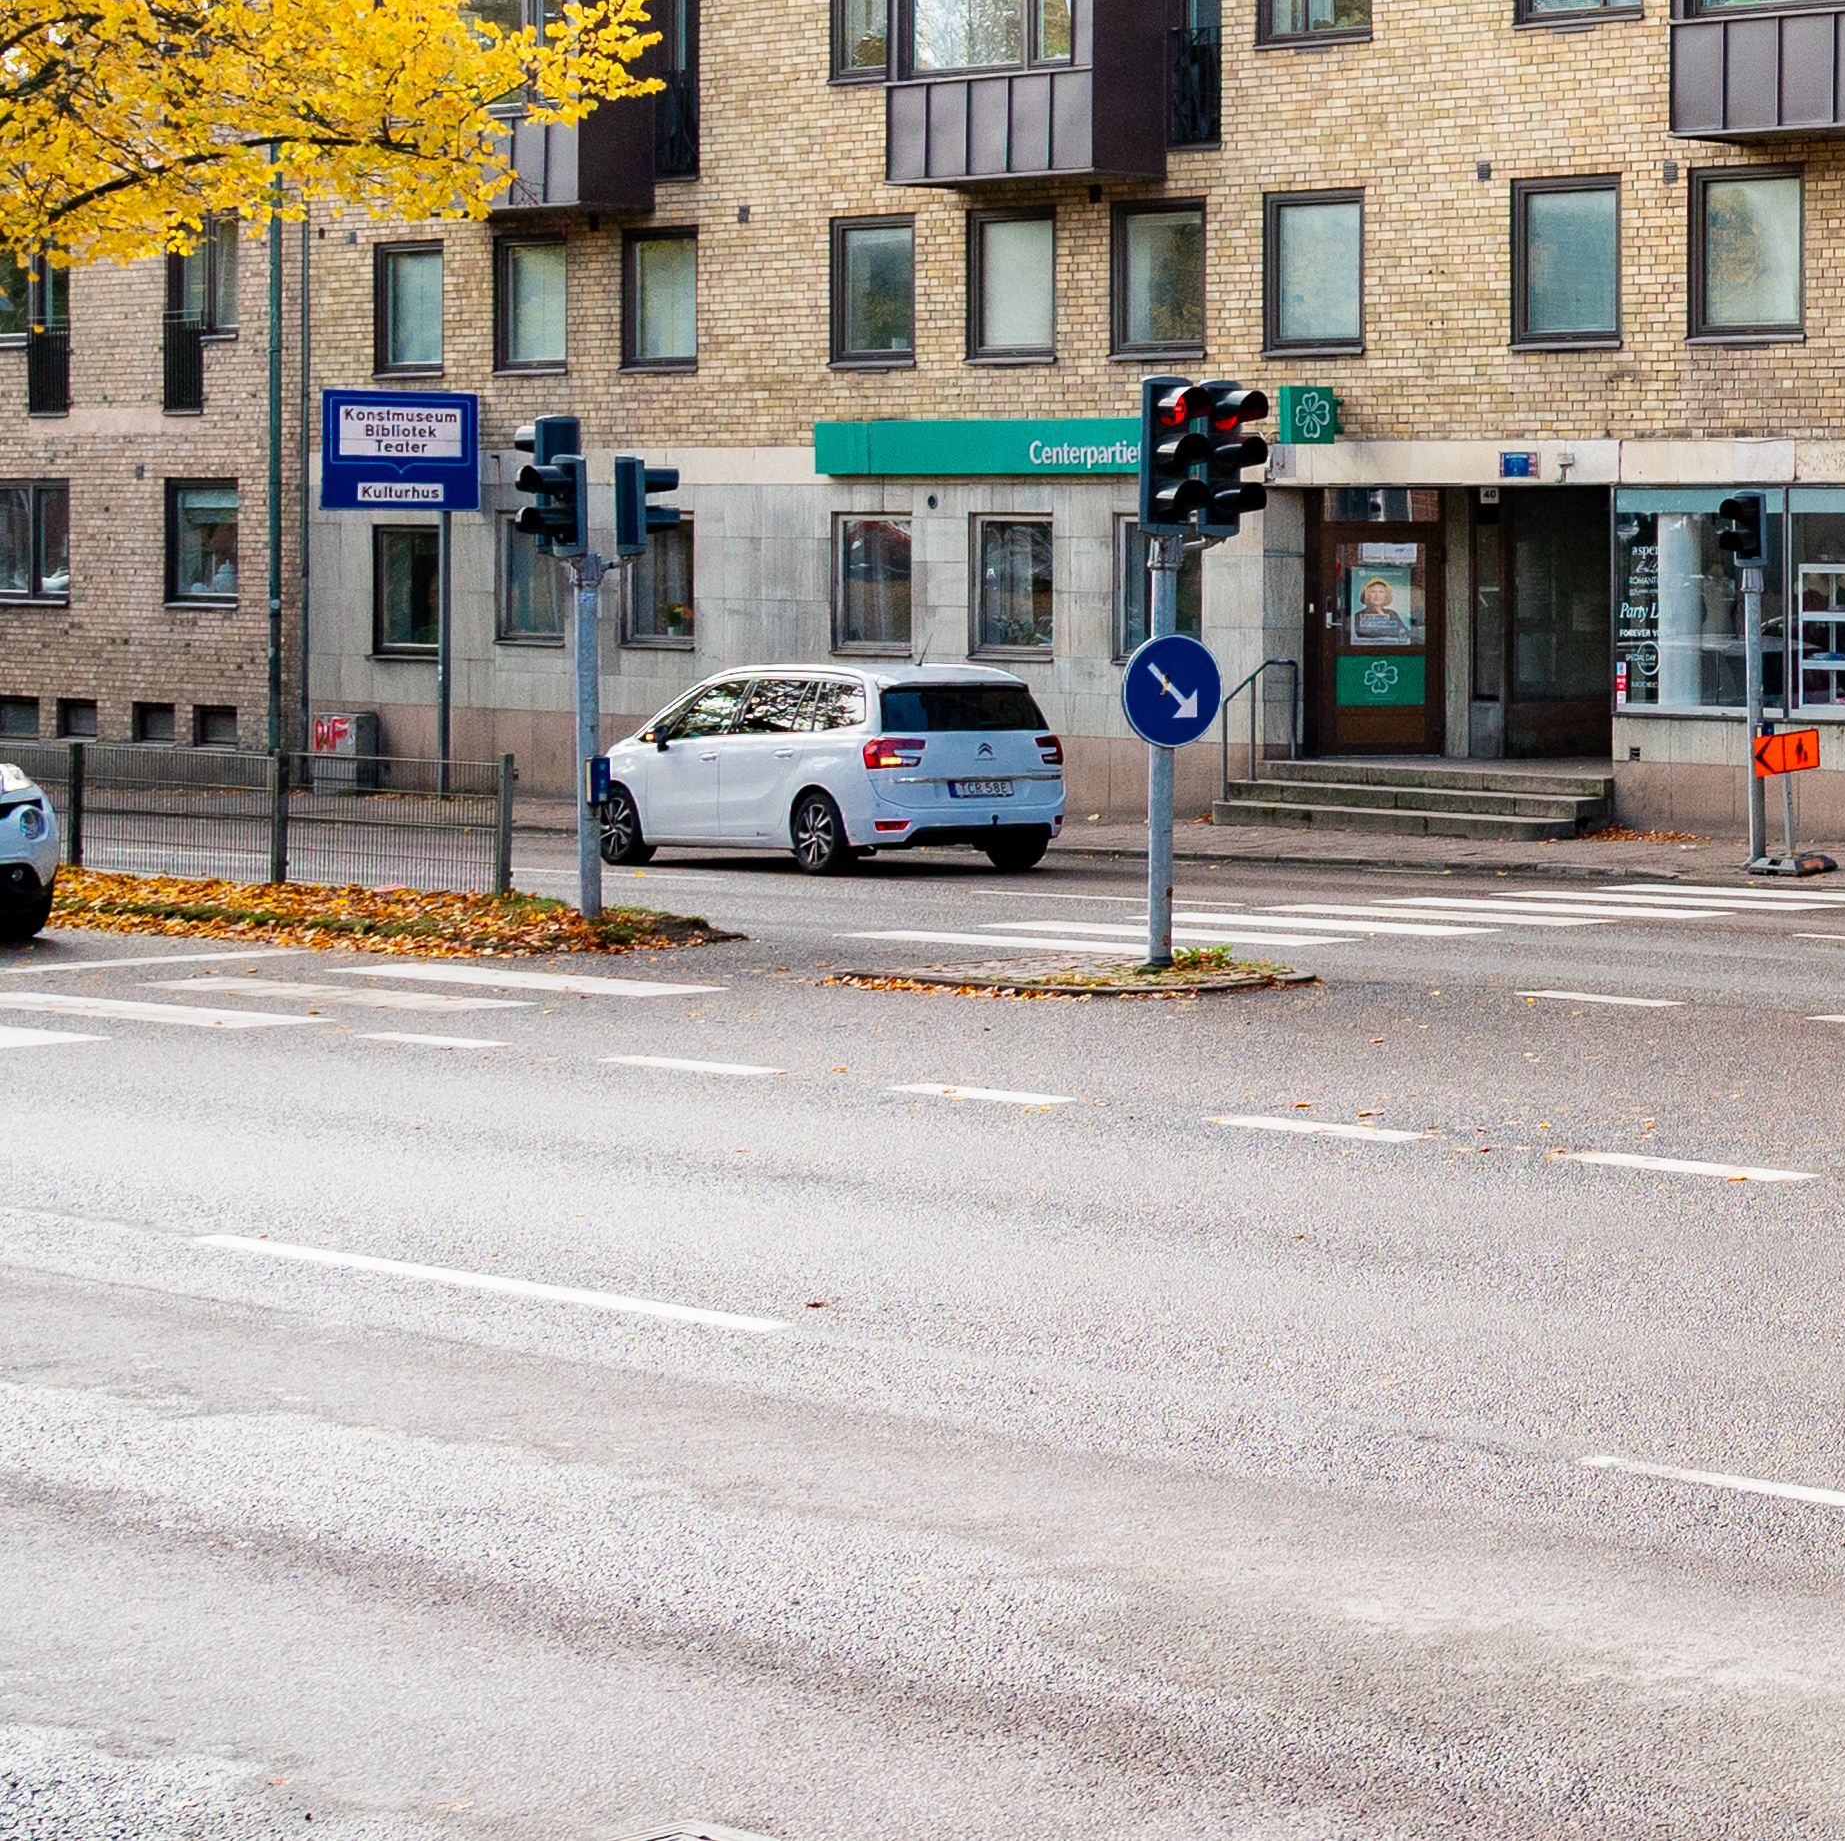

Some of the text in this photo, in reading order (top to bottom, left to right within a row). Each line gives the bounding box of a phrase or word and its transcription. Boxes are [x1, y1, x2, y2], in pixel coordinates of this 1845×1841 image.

[344, 408, 458, 423] Konstmuseum
[365, 424, 437, 438] Bibliotek
[375, 439, 428, 453] Teater
[362, 486, 440, 499] Kulturhus
[1483, 489, 1497, 499] 40
[1619, 602, 1649, 624] Party
[1619, 628, 1651, 638] FOREVER
[960, 782, 983, 794] TCR
